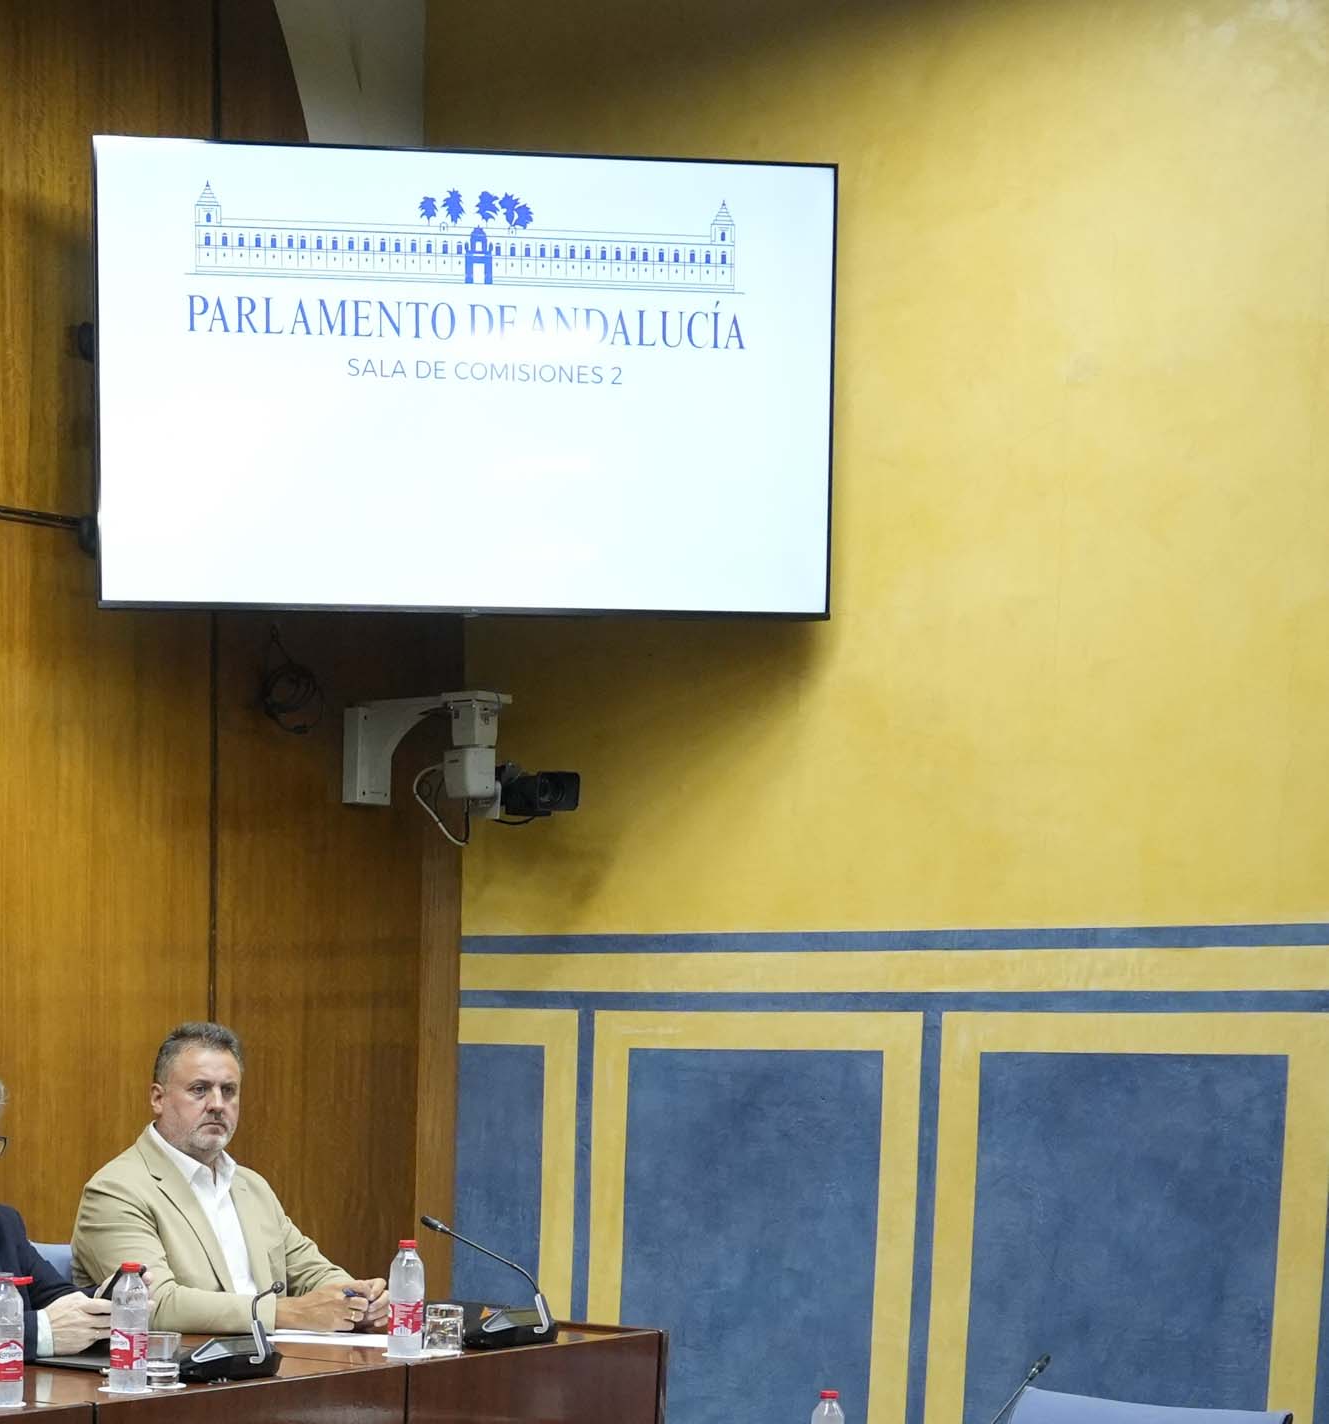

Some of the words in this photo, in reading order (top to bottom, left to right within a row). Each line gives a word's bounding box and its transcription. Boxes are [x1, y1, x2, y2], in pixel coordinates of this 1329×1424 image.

[187, 293, 456, 341] PARLAMENTO
[531, 300, 746, 351] ANDALUCÍA
[347, 358, 407, 379] SALA
[415, 360, 447, 380] DE
[454, 361, 604, 385] COMISIONES
[610, 366, 623, 385] 2
